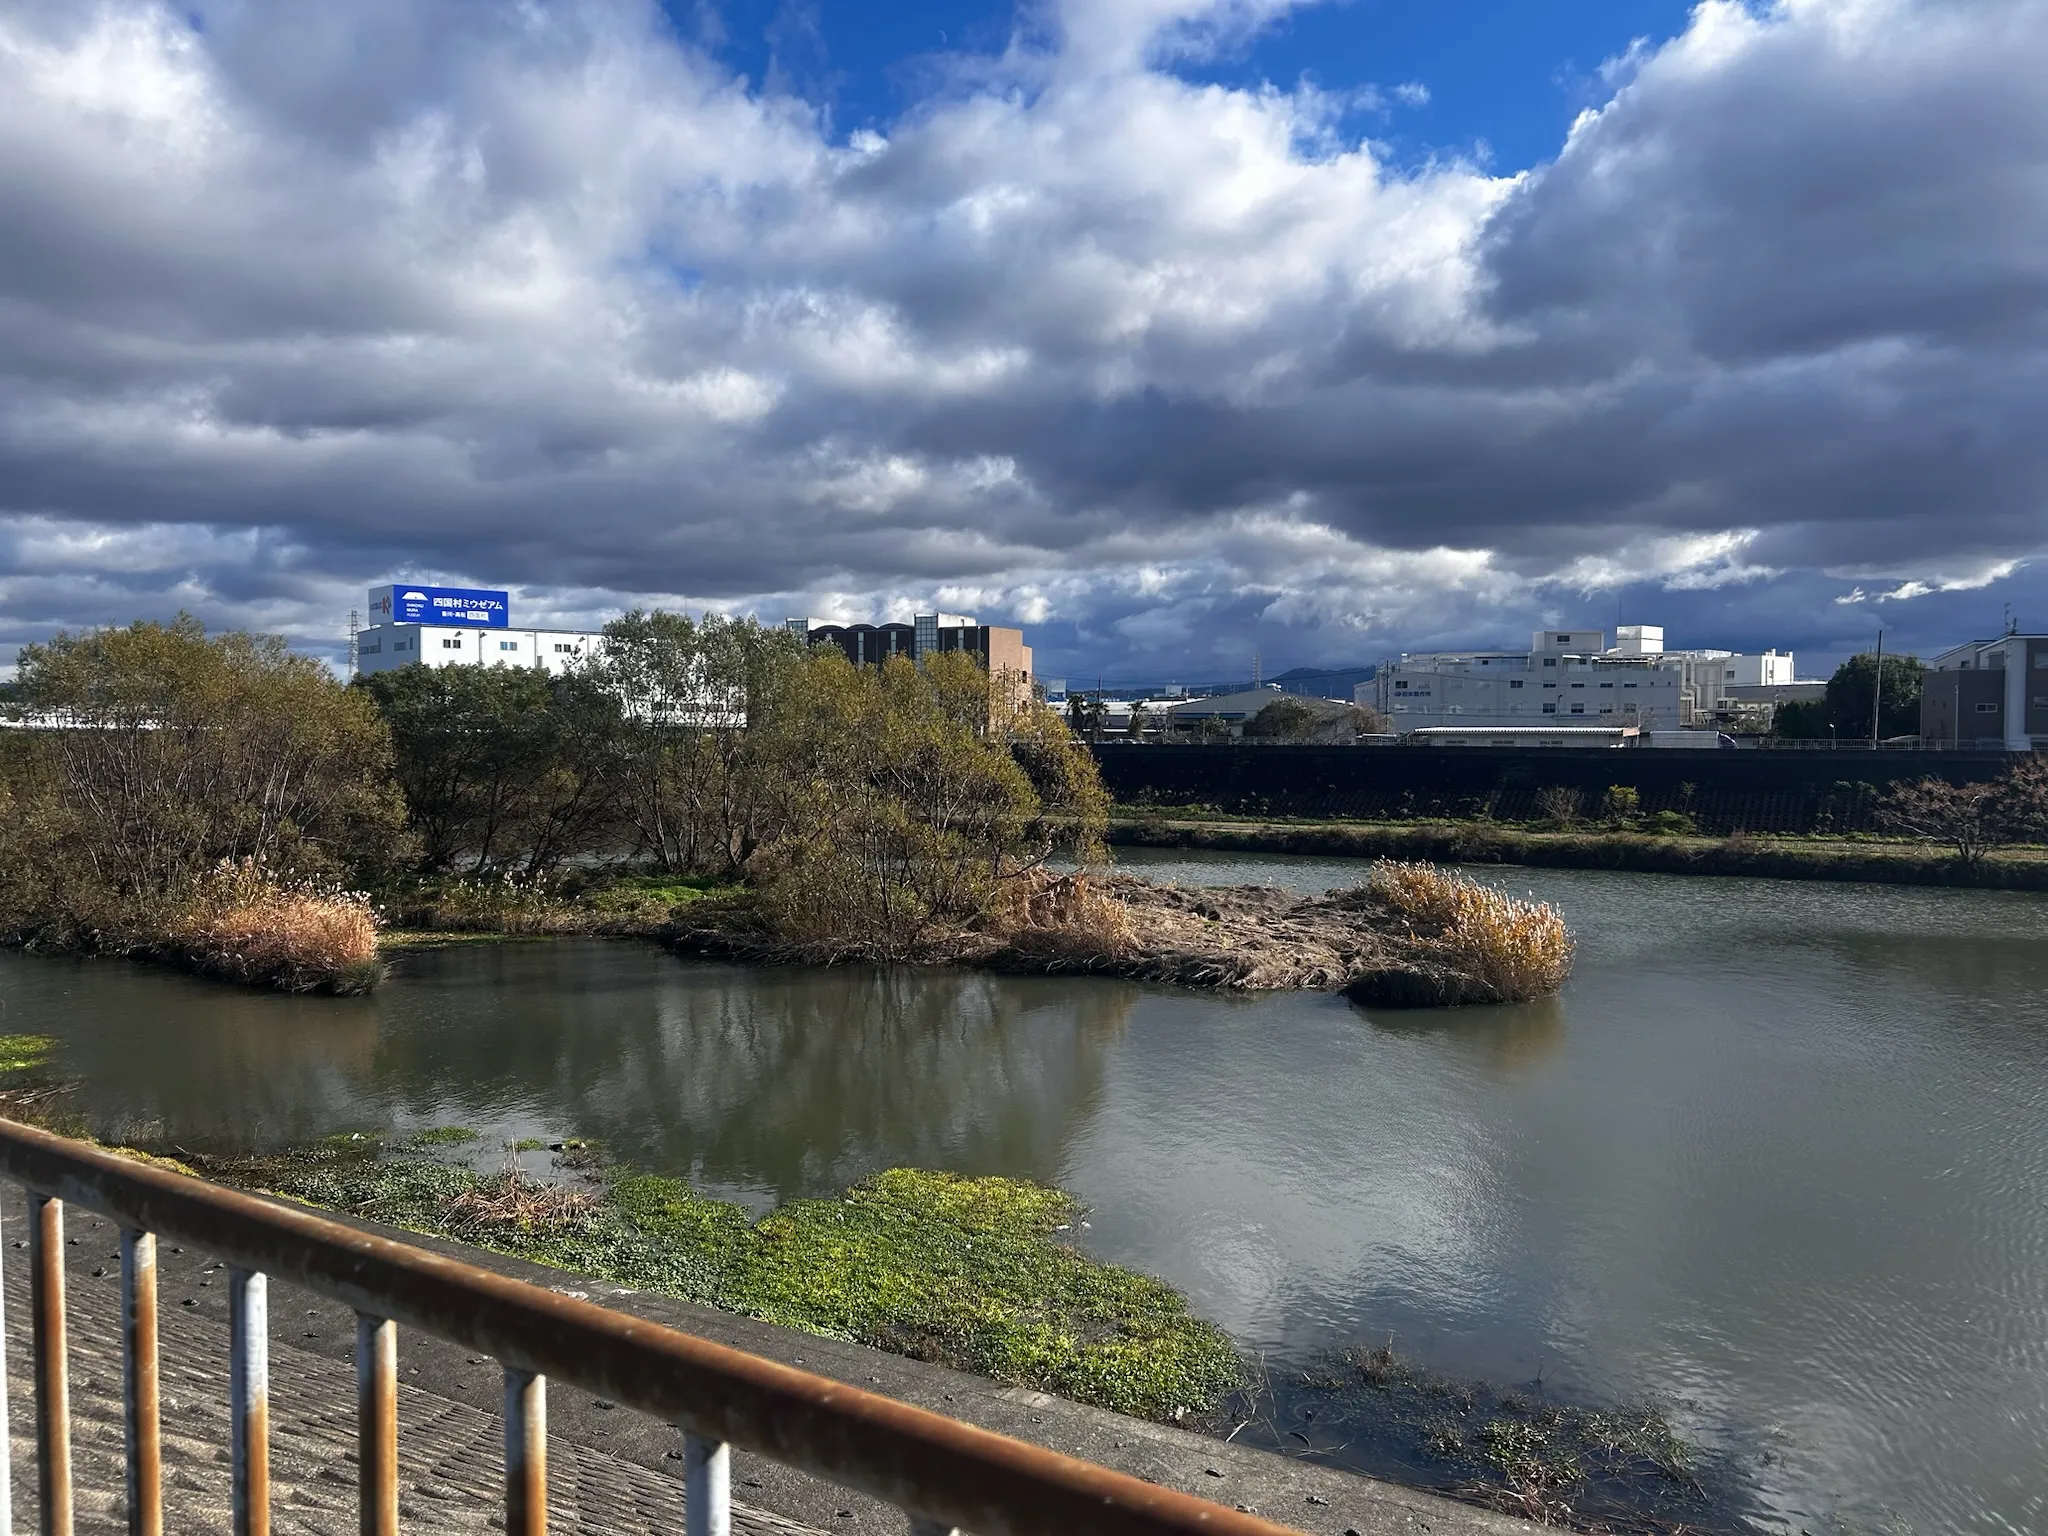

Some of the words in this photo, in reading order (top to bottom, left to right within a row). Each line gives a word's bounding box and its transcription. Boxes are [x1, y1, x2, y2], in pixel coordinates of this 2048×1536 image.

[433, 597, 503, 610] 四国村ミウゼアム
